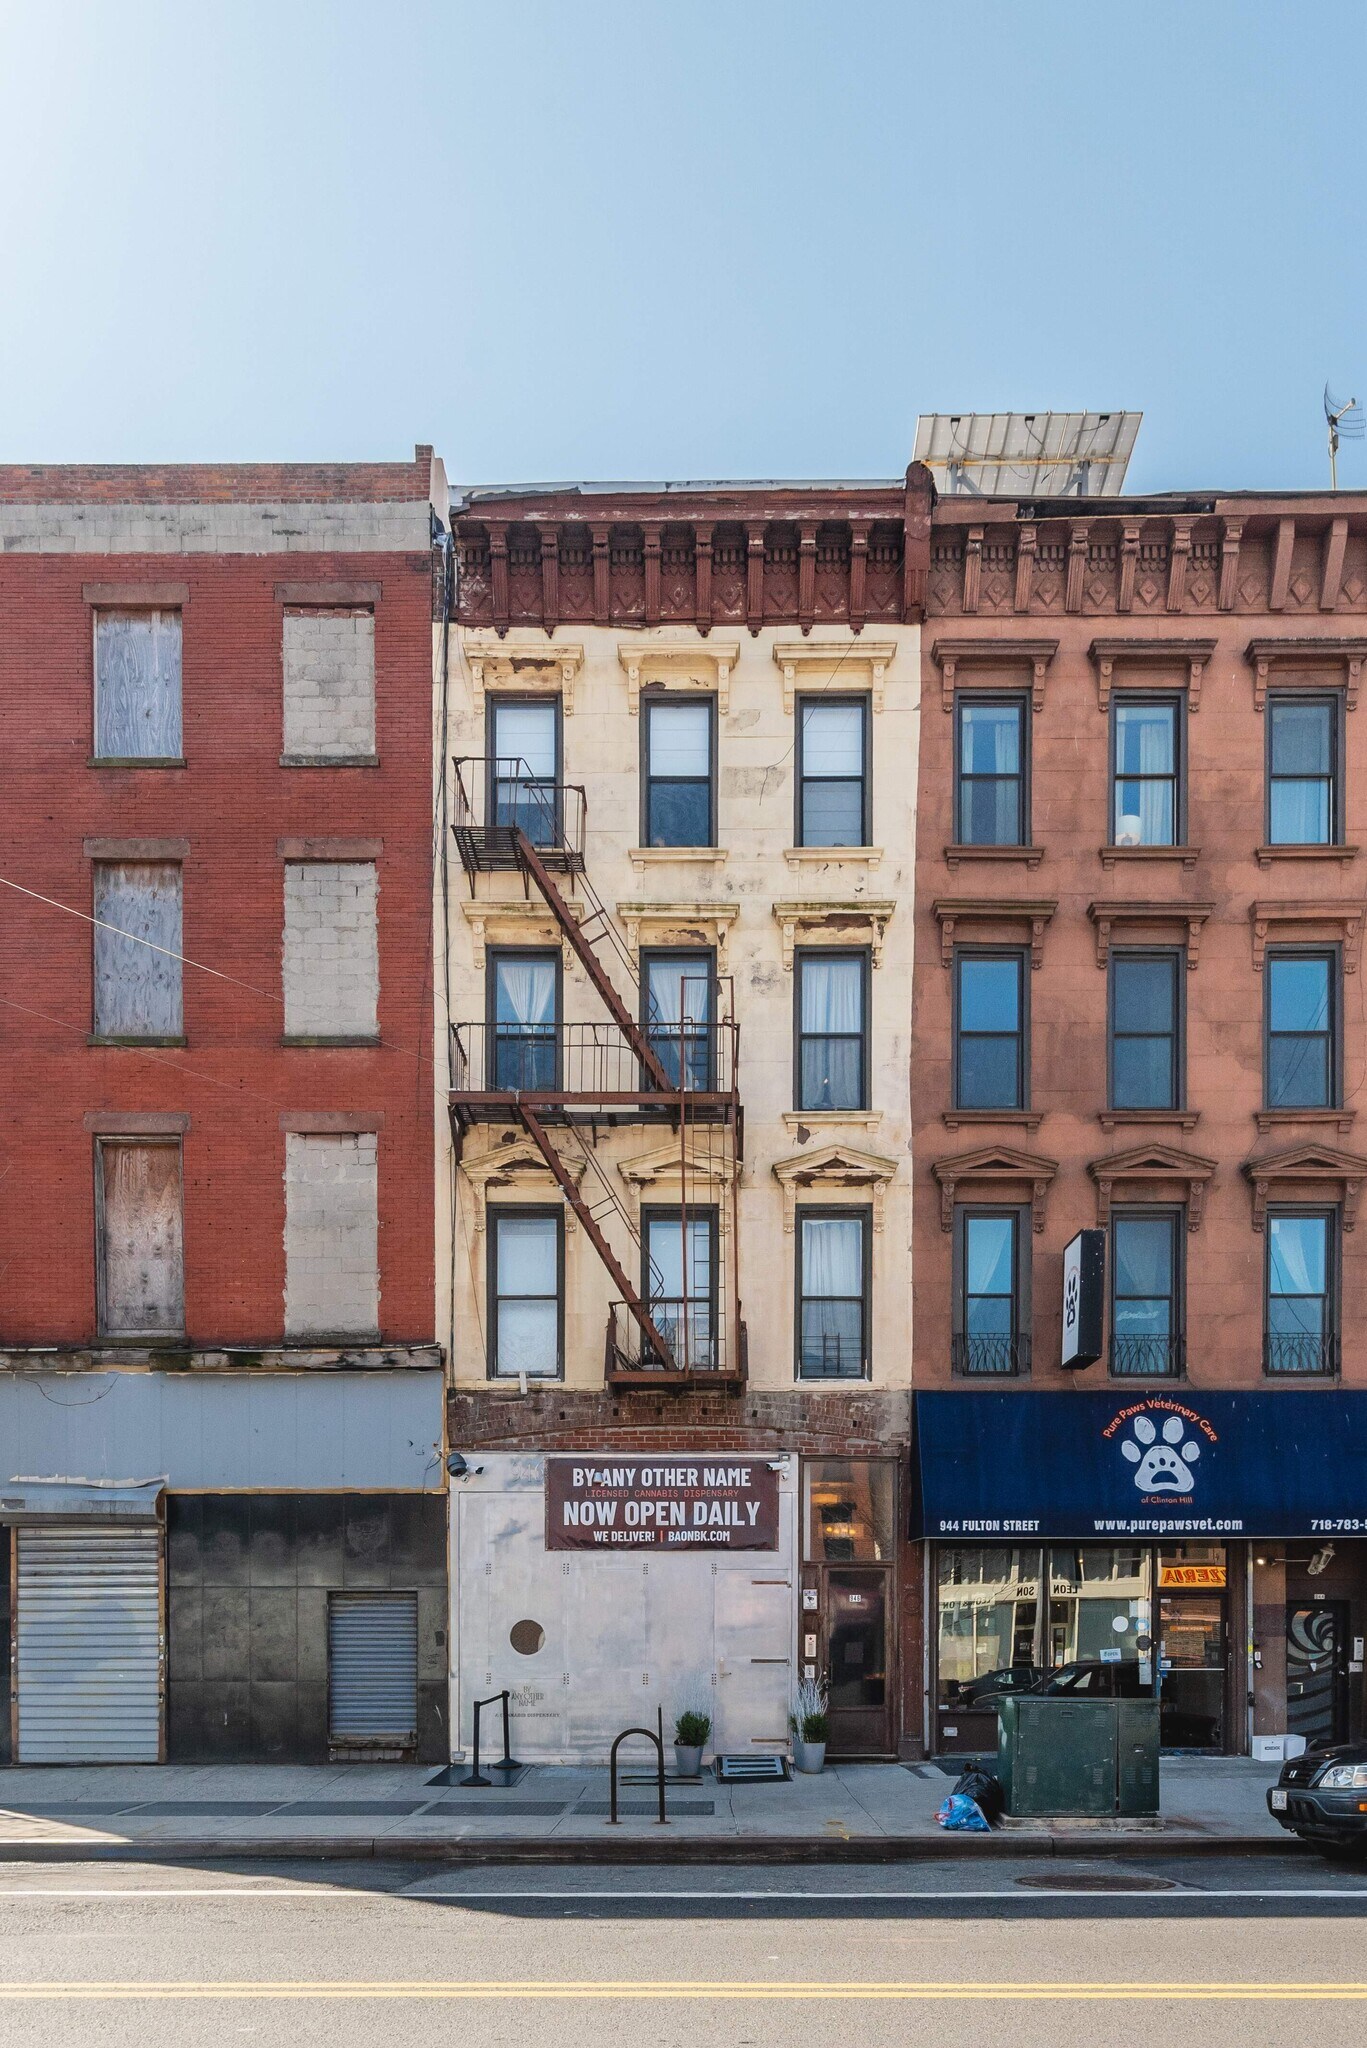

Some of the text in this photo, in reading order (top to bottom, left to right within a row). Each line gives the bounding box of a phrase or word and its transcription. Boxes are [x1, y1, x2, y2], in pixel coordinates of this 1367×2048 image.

[1103, 1400, 1218, 1442] Pure Paws Veterinary Care
[573, 1468, 751, 1487] BY ANY OTHER NAME
[585, 1489, 739, 1498] LICENSED CANNABIS DISPENSARY
[1140, 1496, 1193, 1504] of Clinton Hill
[563, 1501, 760, 1526] NOW OPEN DAILY
[940, 1520, 1040, 1531] 944 FULTON STREET
[1094, 1518, 1243, 1533] www.purepawsvet.com
[593, 1530, 730, 1542] WE DELIVER! BAONBK.COM
